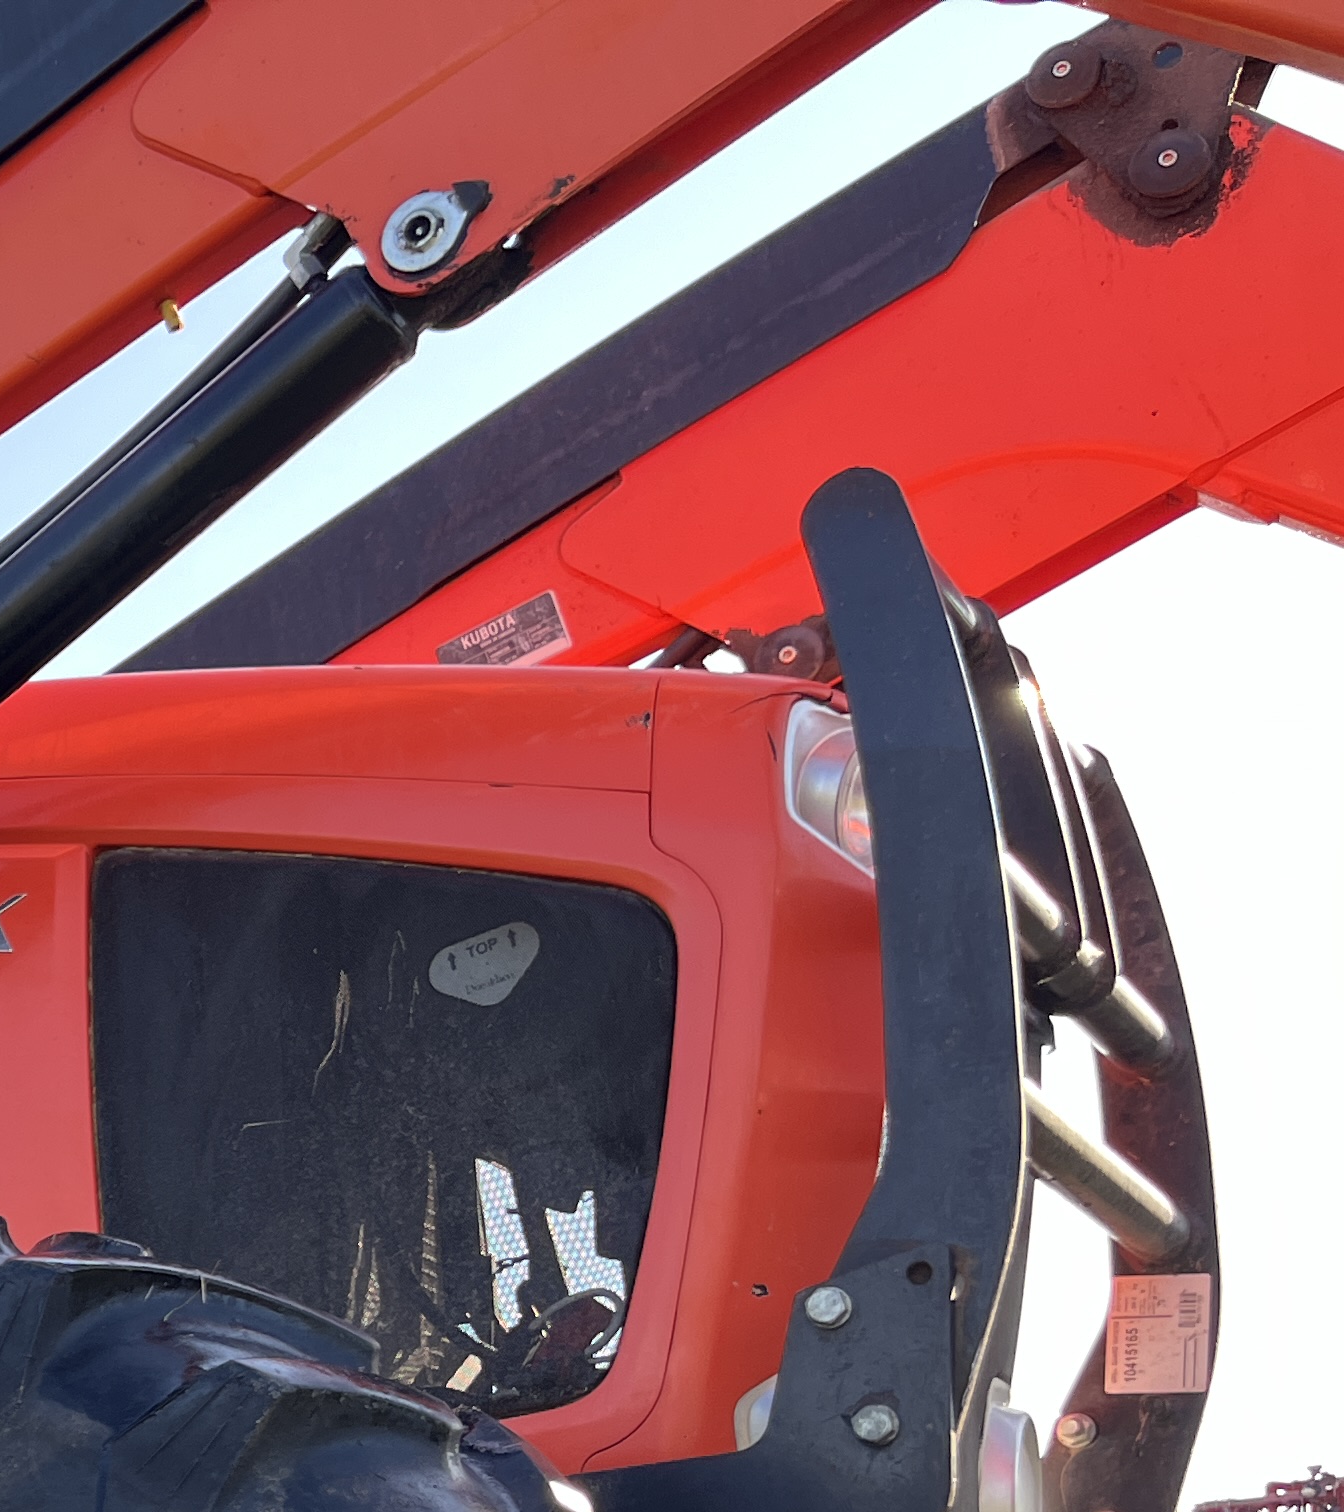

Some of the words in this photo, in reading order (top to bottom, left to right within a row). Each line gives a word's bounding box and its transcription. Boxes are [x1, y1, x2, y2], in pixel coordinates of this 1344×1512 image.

[460, 614, 516, 650] KUBOTA
[465, 937, 498, 958] TOP
[1124, 1328, 1138, 1382] 10415165
